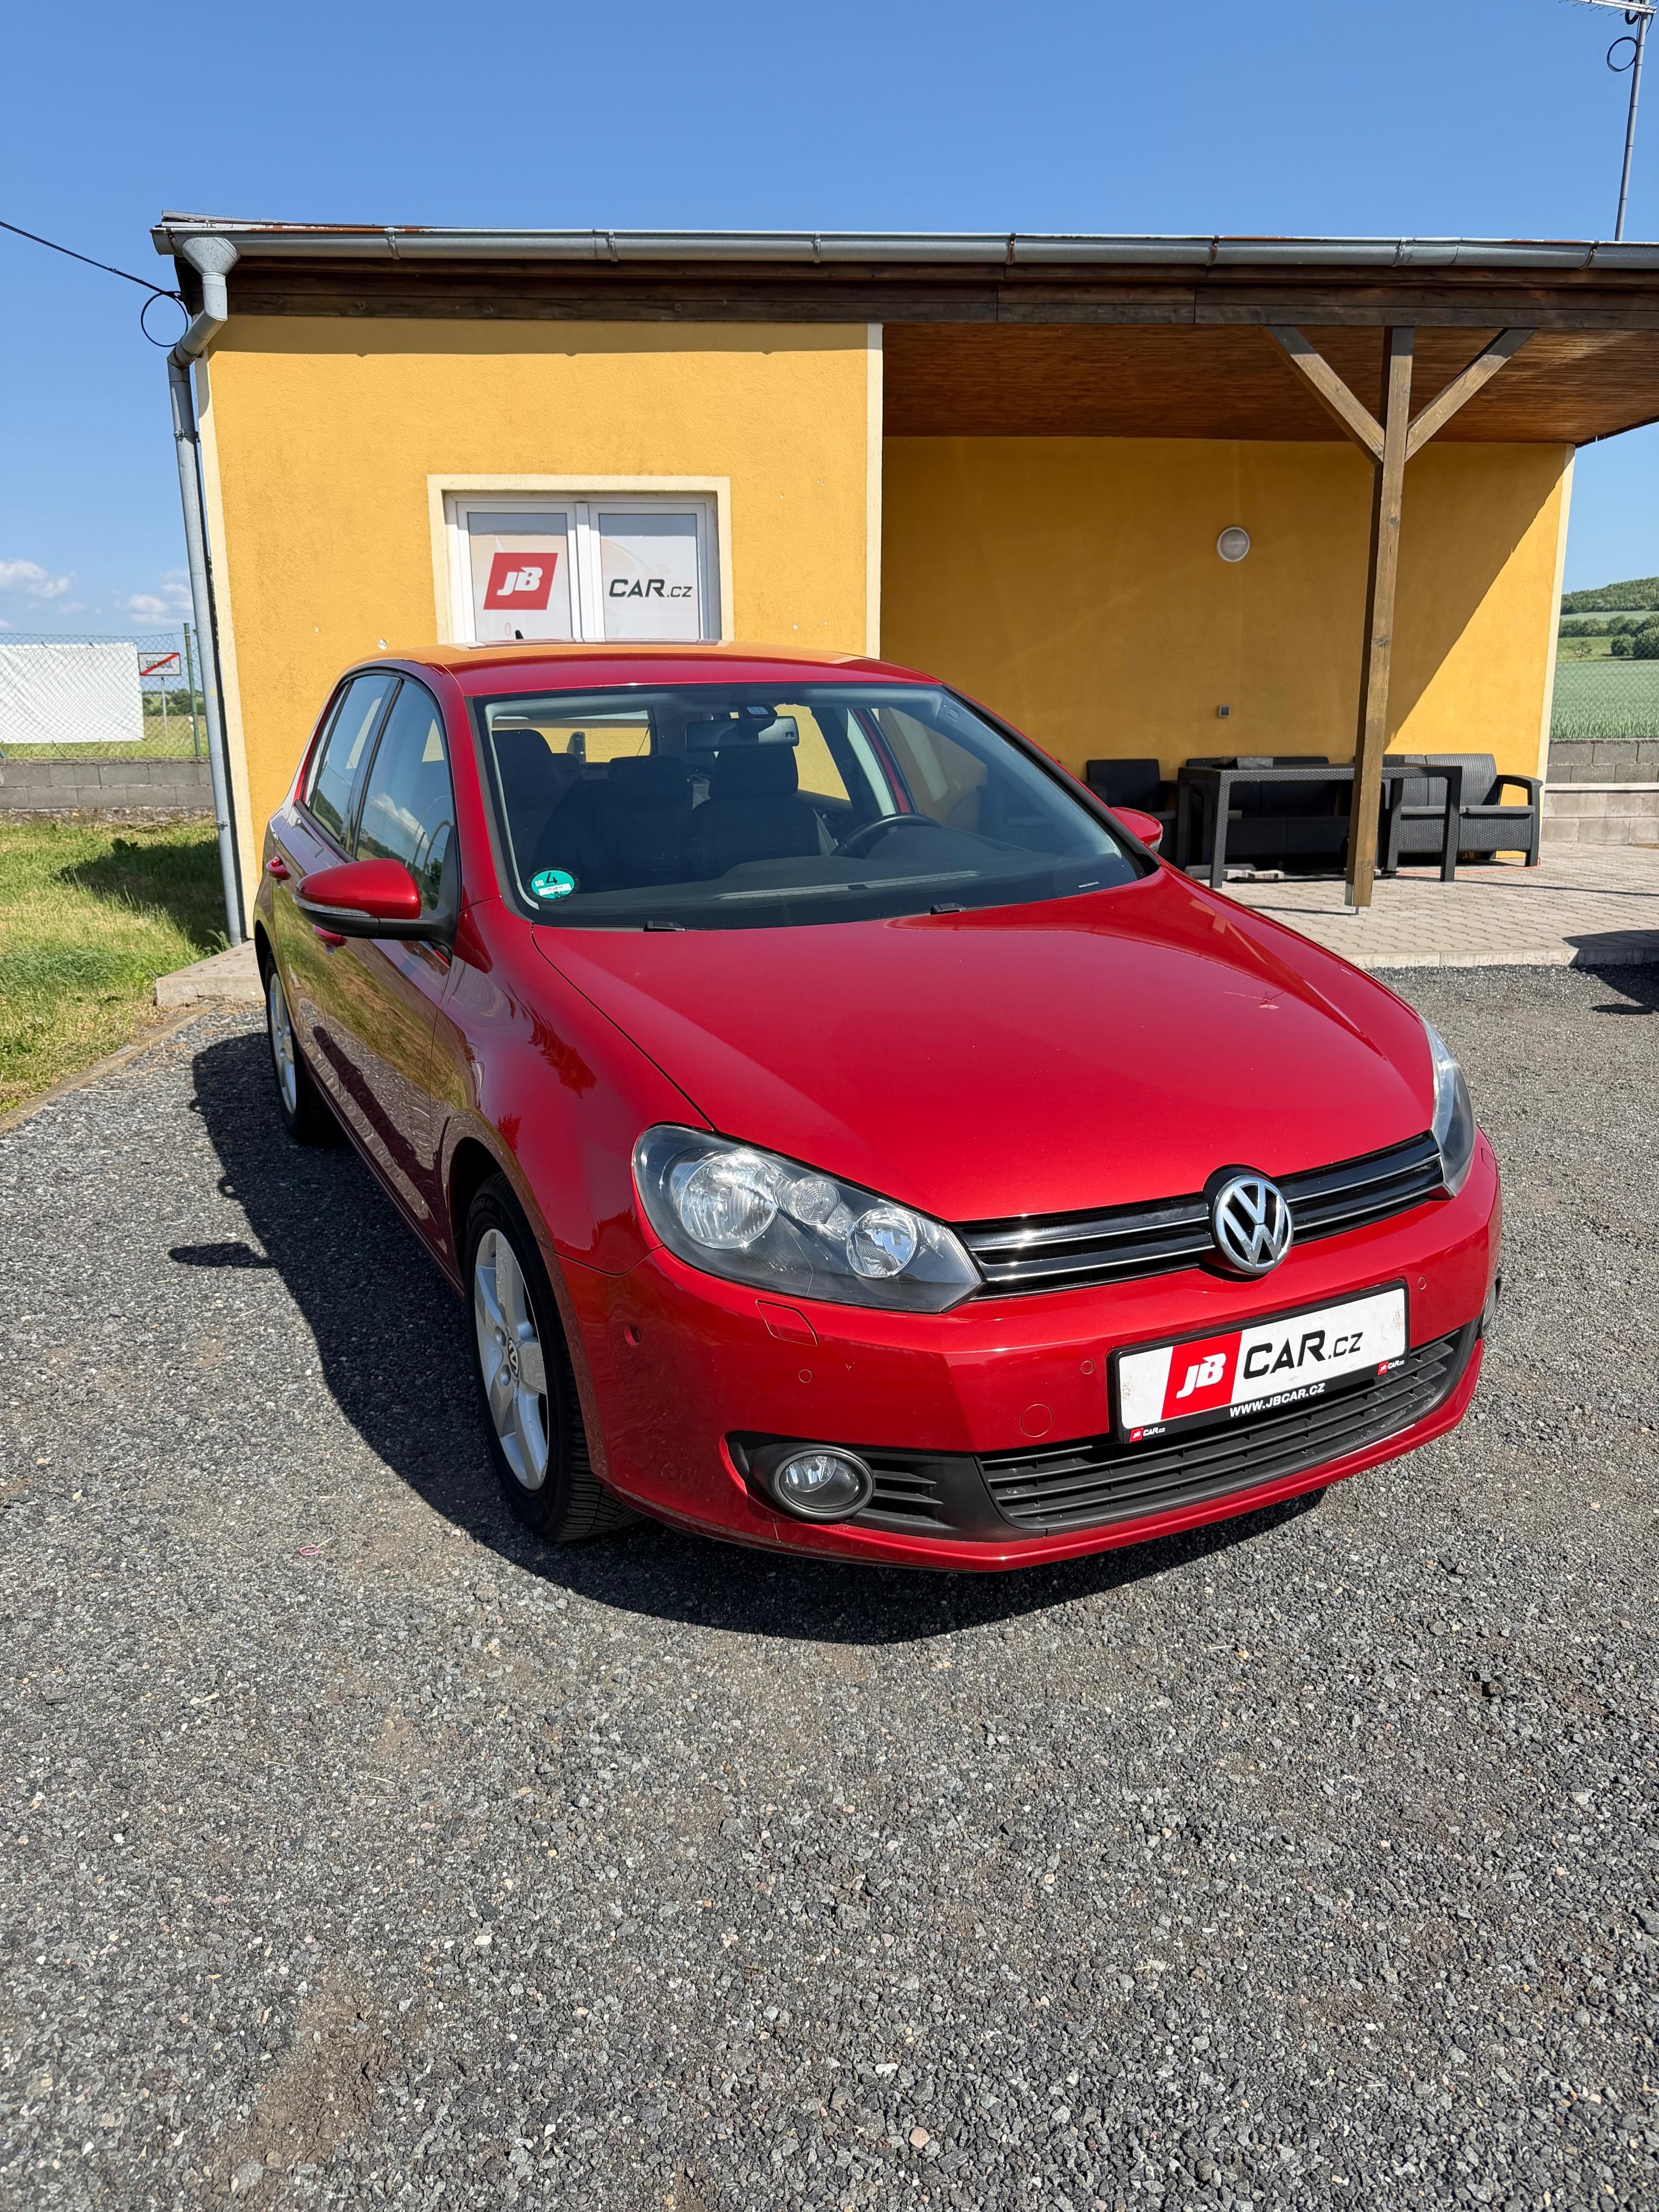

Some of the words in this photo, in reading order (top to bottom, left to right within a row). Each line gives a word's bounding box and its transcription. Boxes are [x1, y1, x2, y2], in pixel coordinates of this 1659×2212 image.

[496, 566, 543, 596] JB
[545, 872, 558, 884] 4
[1218, 1179, 1290, 1270] VW
[1176, 1352, 1227, 1399] JB
[1229, 1382, 1326, 1418] WWW.JBCAR.CZ
